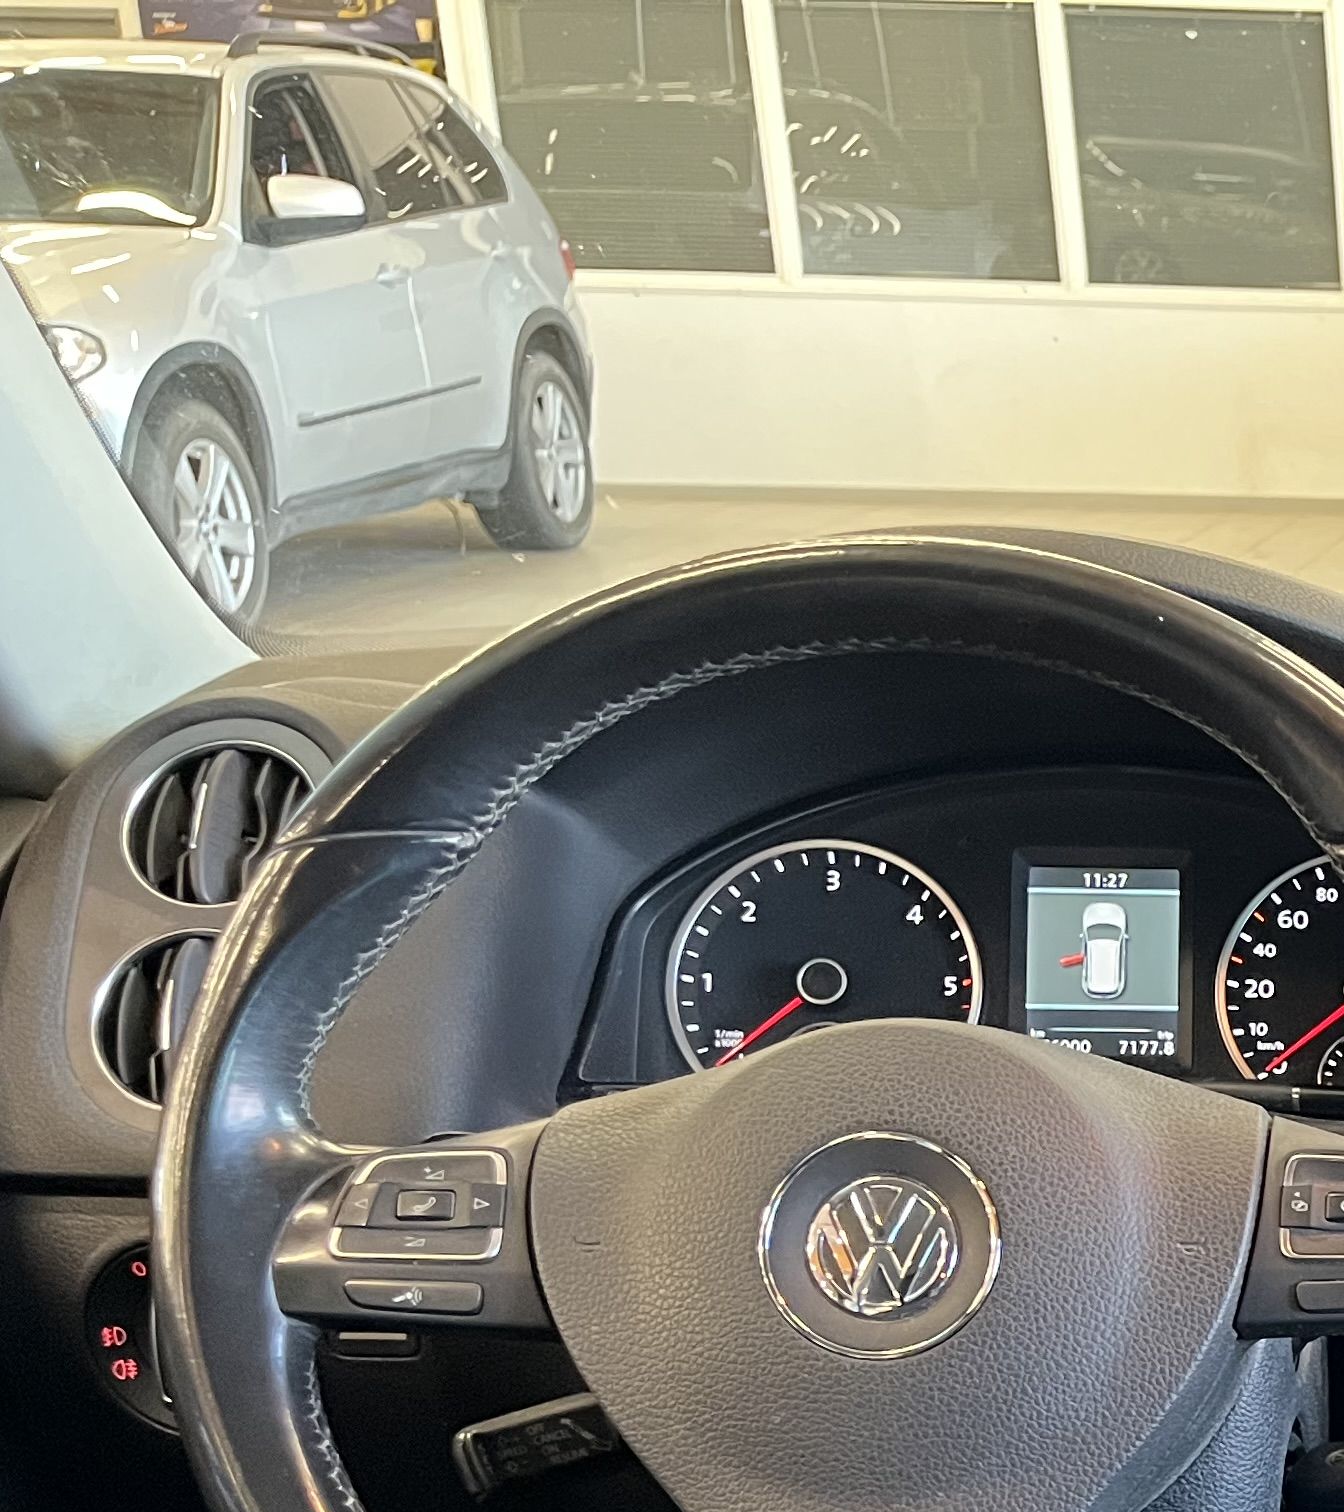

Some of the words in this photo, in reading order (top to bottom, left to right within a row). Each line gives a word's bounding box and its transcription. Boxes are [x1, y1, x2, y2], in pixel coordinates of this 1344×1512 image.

[826, 869, 841, 892] 3
[1083, 872, 1129, 888] 11:27
[1315, 886, 1339, 903] 80
[741, 900, 756, 924] 2
[905, 904, 924, 926] 4
[1276, 909, 1309, 930] 60
[1252, 942, 1277, 958] 40
[702, 971, 713, 993] 1
[943, 975, 958, 997] 5
[1244, 978, 1275, 999] 20
[1249, 1022, 1269, 1037] 10
[1118, 1040, 1176, 1056] 7177.8
